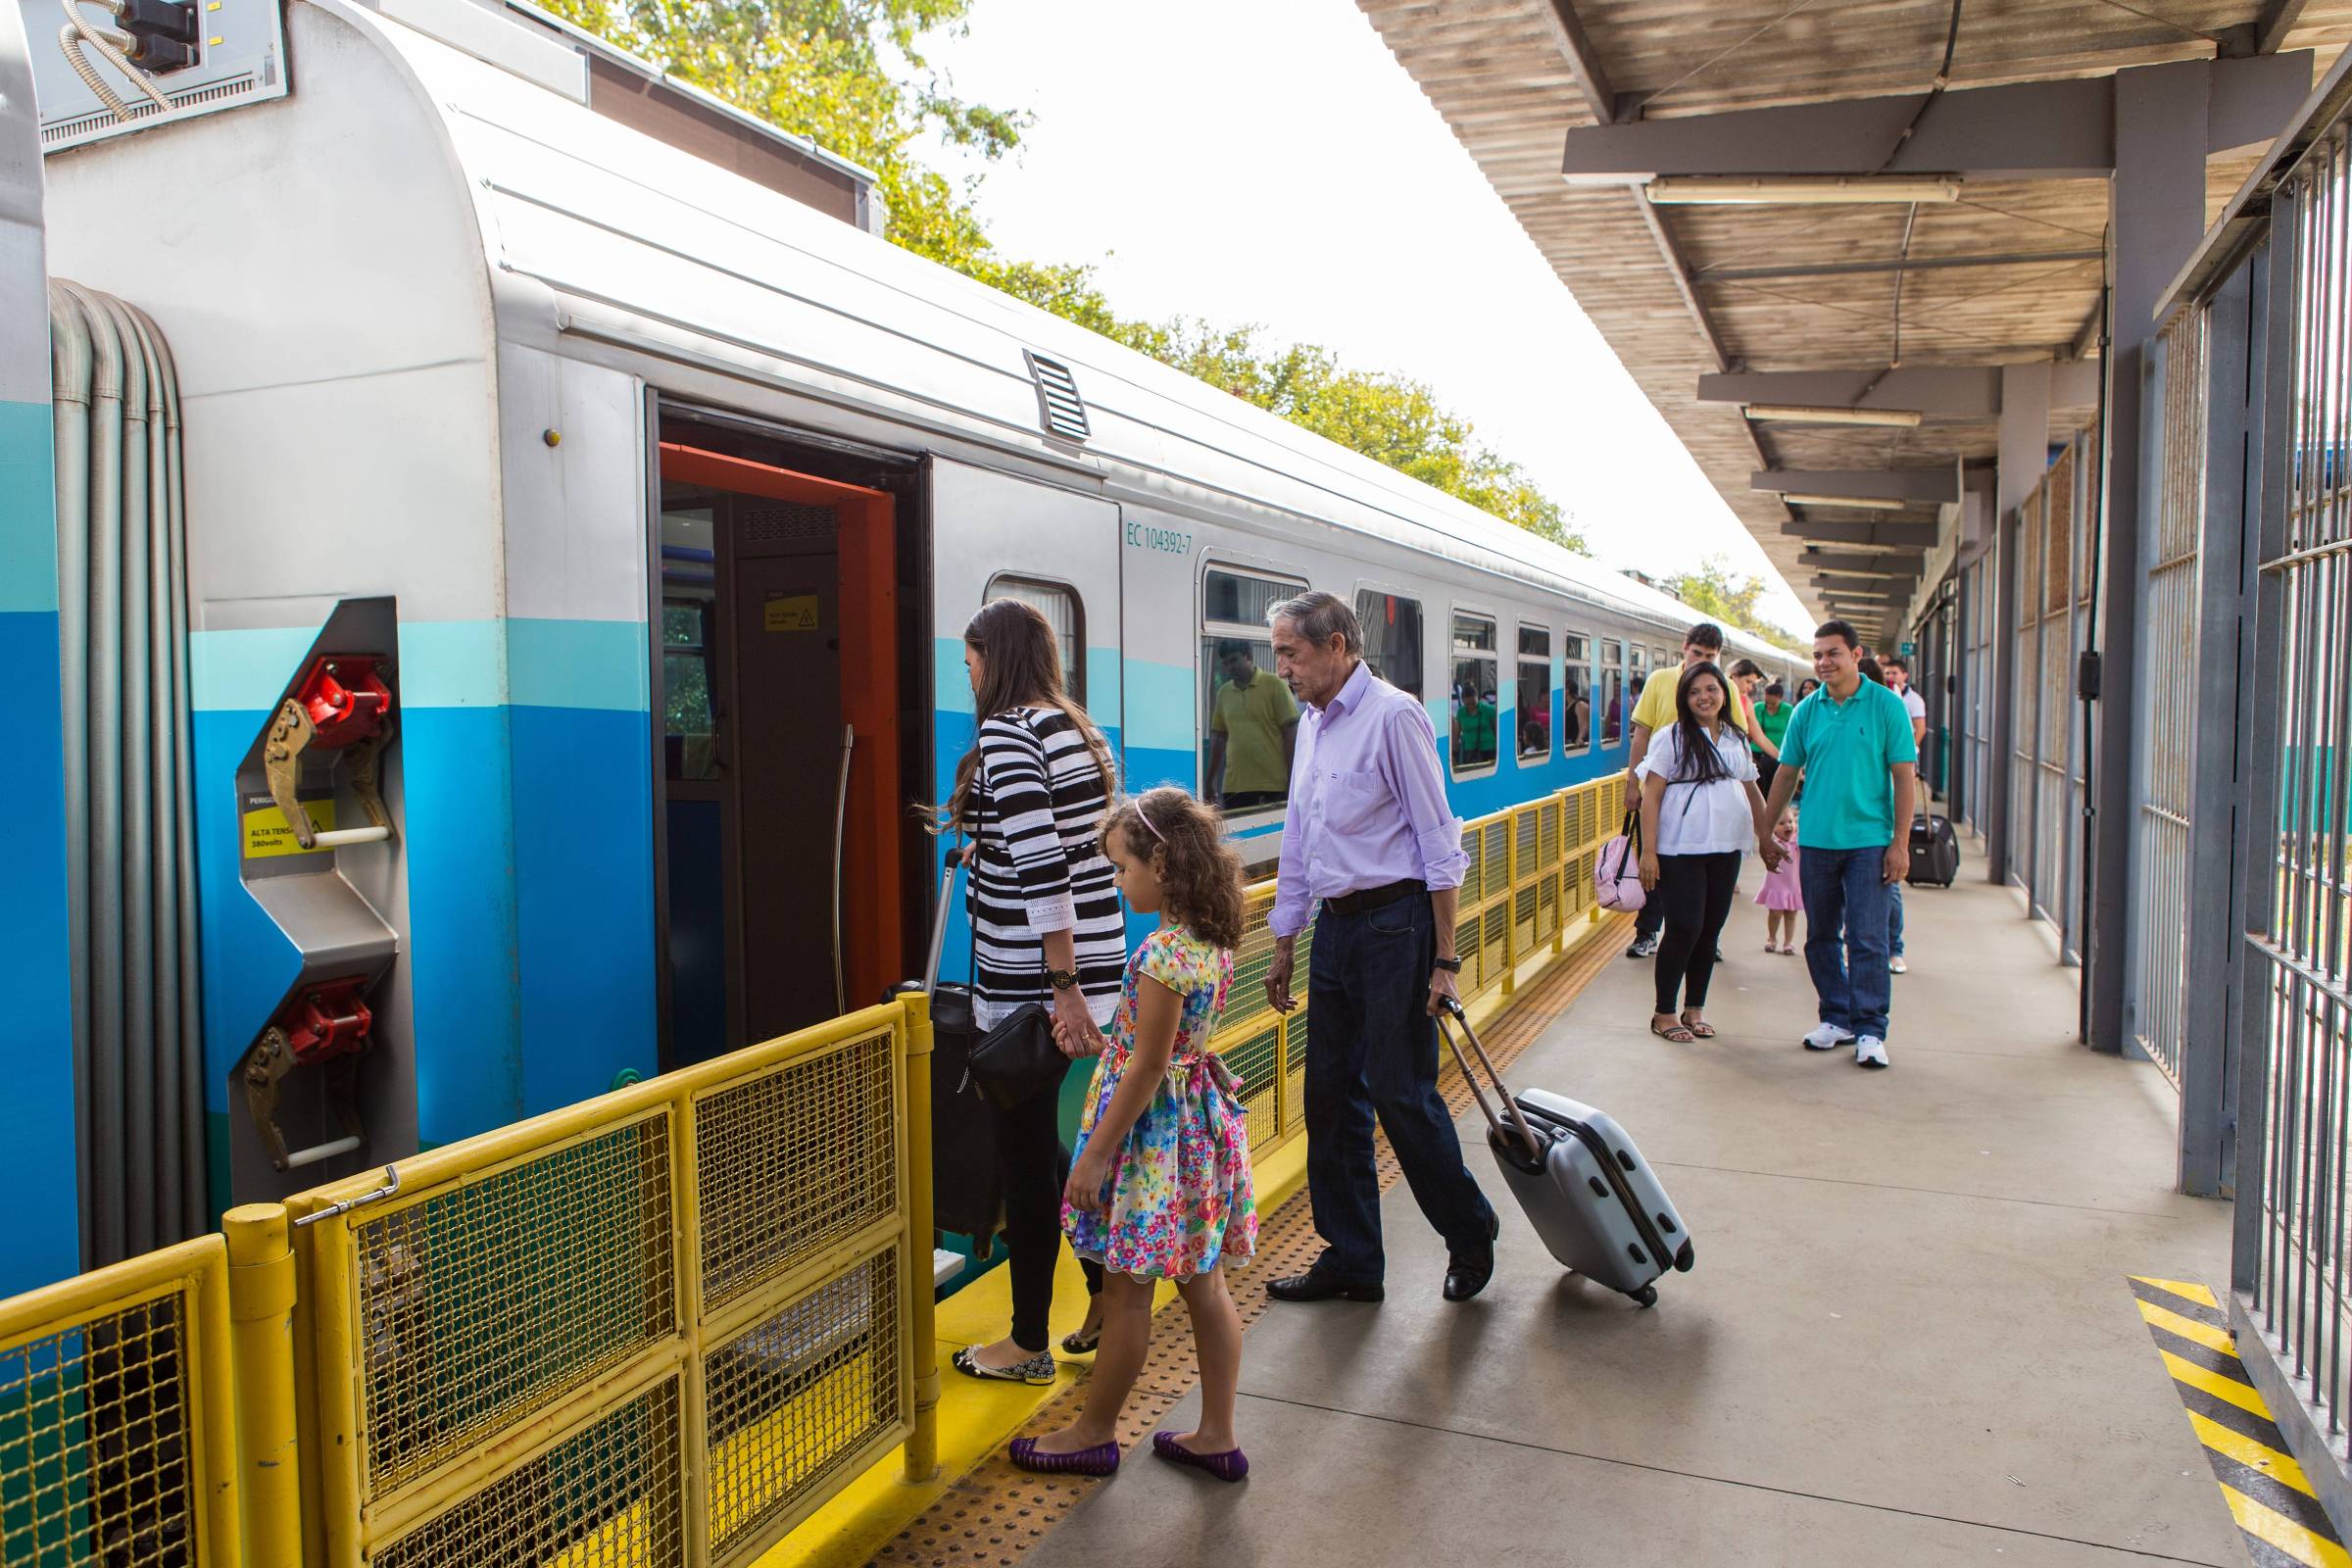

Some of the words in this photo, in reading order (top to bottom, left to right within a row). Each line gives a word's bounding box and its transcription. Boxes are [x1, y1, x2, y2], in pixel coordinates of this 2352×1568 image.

[1128, 522, 1142, 547] EC
[1146, 527, 1192, 556] 104392-7
[272, 827, 294, 836] TENS
[251, 839, 283, 848] 380volts
